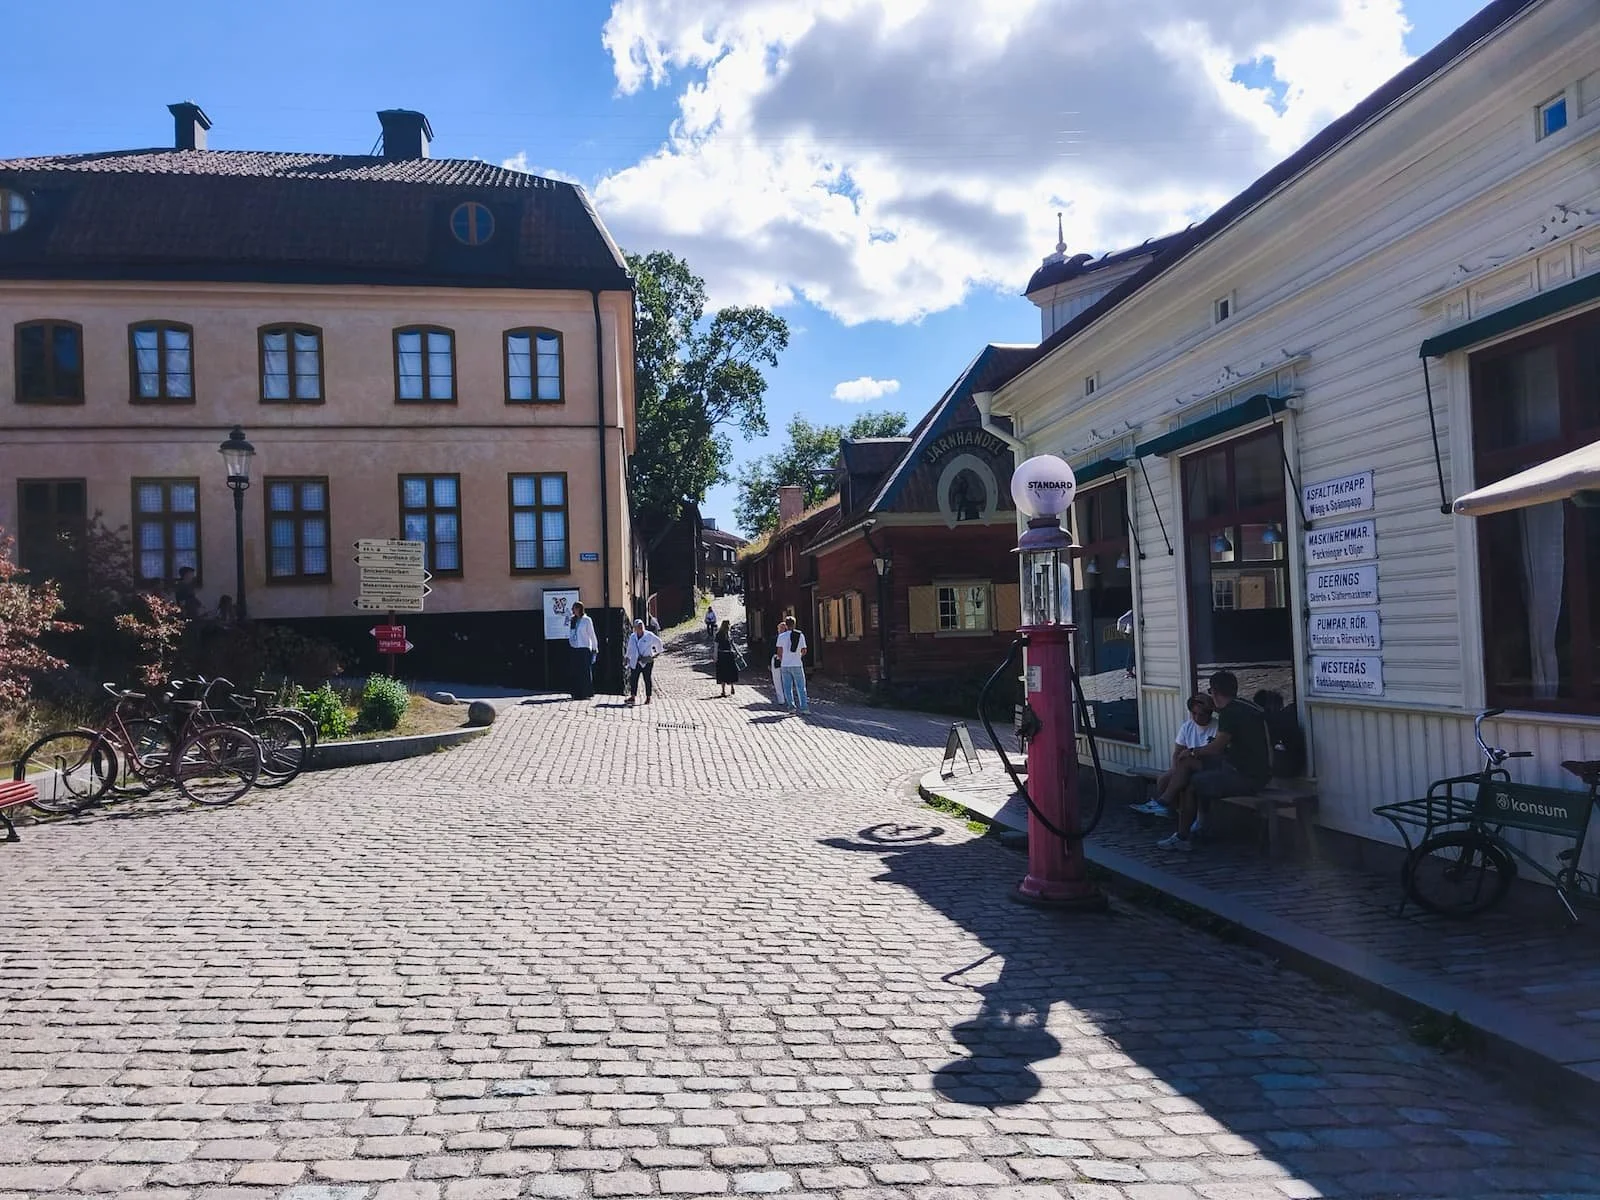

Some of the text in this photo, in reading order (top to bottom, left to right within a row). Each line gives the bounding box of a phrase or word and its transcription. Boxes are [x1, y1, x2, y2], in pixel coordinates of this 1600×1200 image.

[1028, 481, 1073, 489] STANDARD
[1306, 477, 1365, 500] ASFALTTAKPAPP.
[1308, 526, 1370, 546] MASKINREMMAR.
[1318, 572, 1360, 588] DEERINGS
[1320, 658, 1366, 674] WESTERÅS
[1511, 798, 1568, 819] konsum
